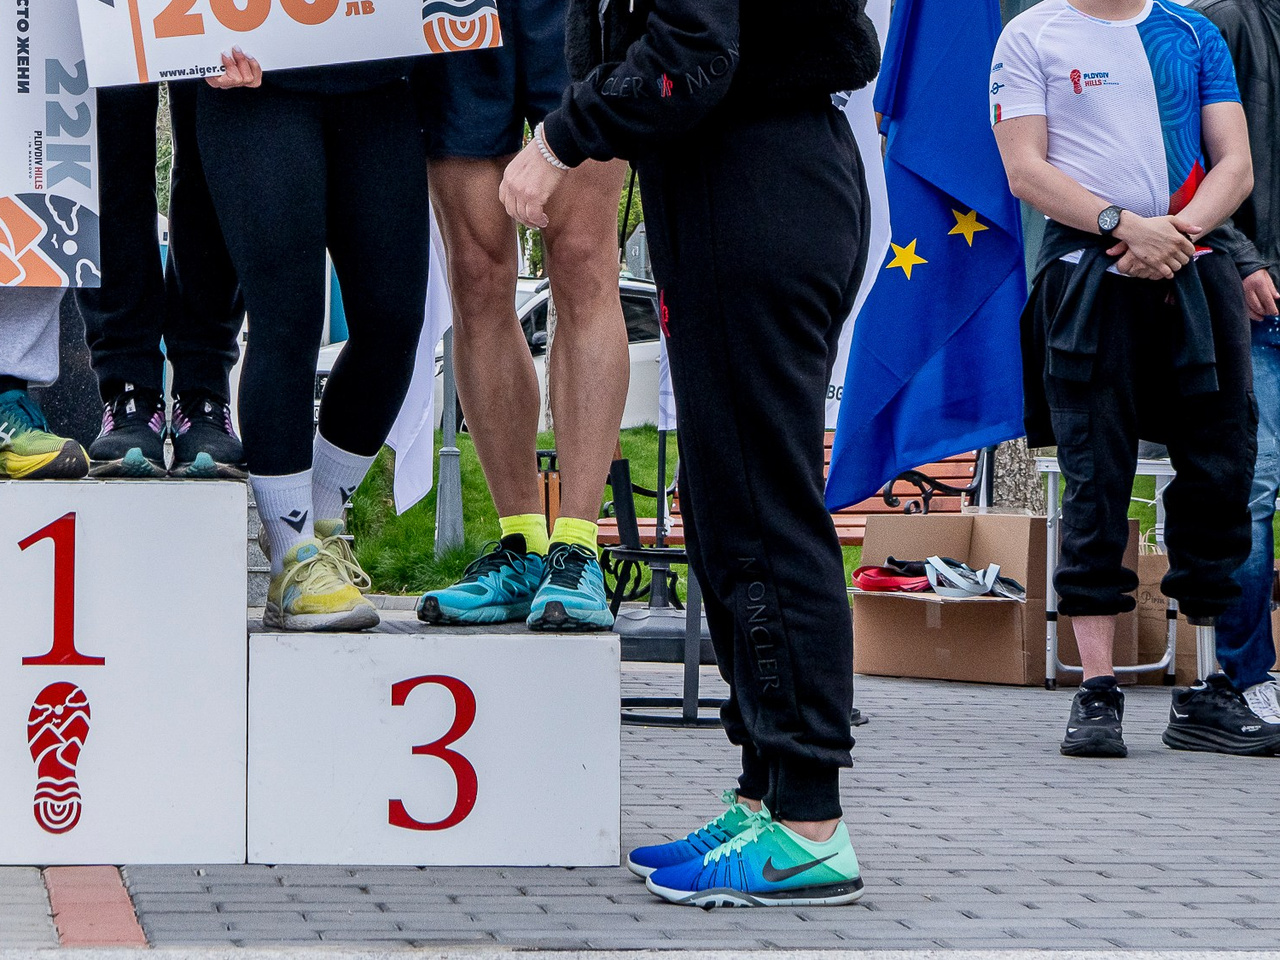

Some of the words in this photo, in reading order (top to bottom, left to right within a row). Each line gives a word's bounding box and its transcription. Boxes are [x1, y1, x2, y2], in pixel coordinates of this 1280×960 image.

[17, 36, 30, 94] ЖЕНИ
[159, 65, 226, 78] www.aiger.c
[34, 130, 43, 166] PLOVDIV
[45, 58, 92, 190] 22K
[34, 167, 43, 190] HILLS
[17, 512, 106, 667] 1
[387, 674, 478, 832] 3
